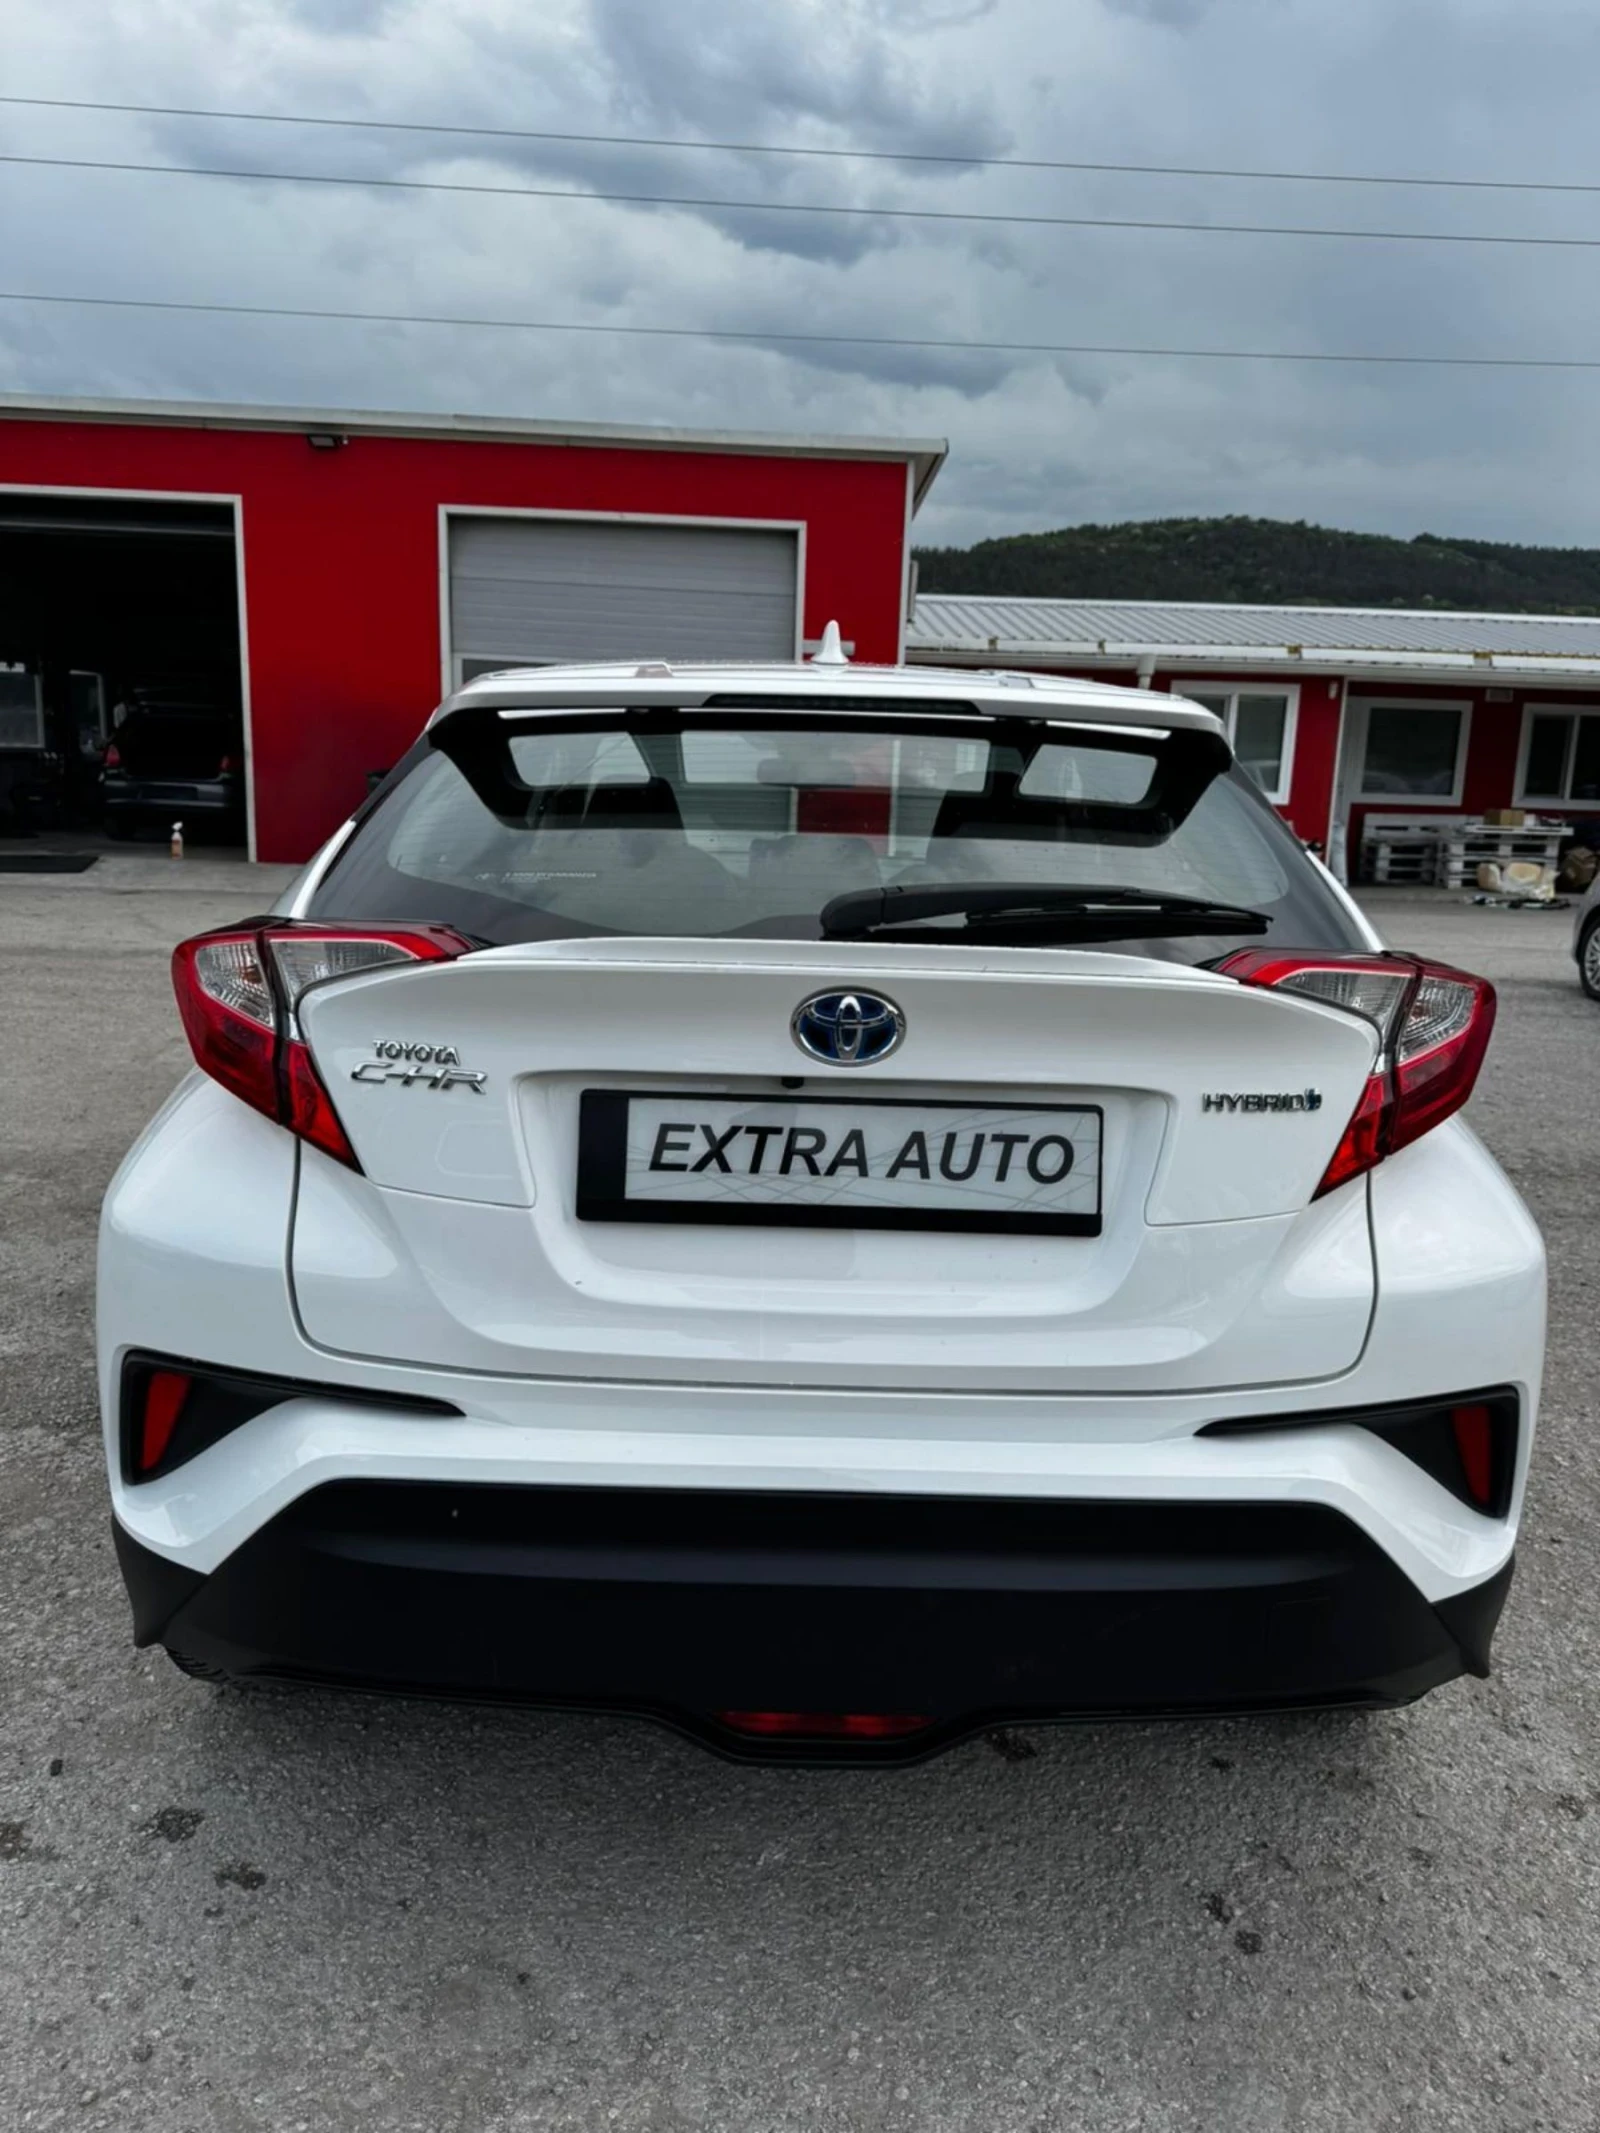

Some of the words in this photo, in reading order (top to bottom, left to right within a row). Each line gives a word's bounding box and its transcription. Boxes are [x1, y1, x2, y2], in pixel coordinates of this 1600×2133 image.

[373, 1039, 461, 1066] TOYOTA
[351, 1060, 488, 1095] C-HR
[1202, 1093, 1305, 1113] HYBRID
[648, 1122, 870, 1178] EXTRA
[886, 1130, 1075, 1185] AUTO
